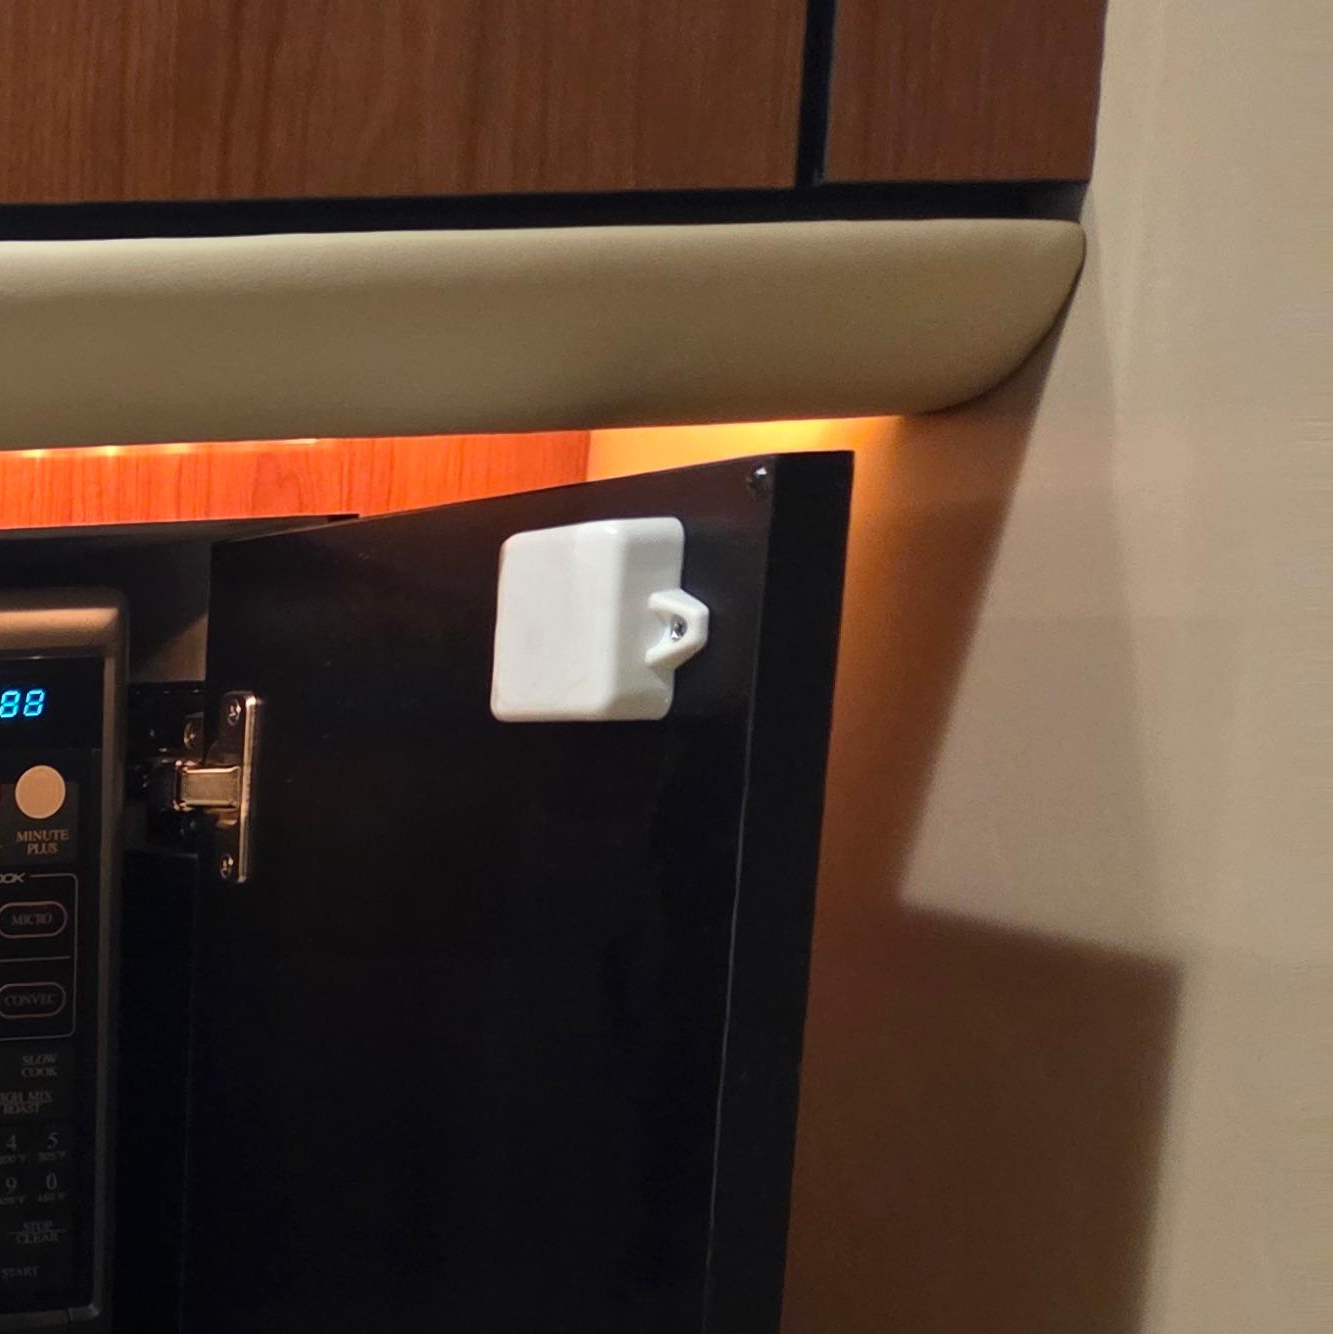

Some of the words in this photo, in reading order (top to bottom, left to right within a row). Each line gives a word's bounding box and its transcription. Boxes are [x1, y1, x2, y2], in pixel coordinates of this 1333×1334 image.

[15, 829, 70, 842] MINUTE
[26, 842, 59, 856] PLUS
[10, 912, 53, 926] MICRO
[21, 1053, 58, 1065] SLOW
[21, 1065, 58, 1078] COOK
[6, 1134, 18, 1152] 4
[47, 1131, 59, 1149] 5
[5, 1177, 17, 1194] 9
[46, 1173, 58, 1190] 0
[0, 1265, 40, 1279] START
